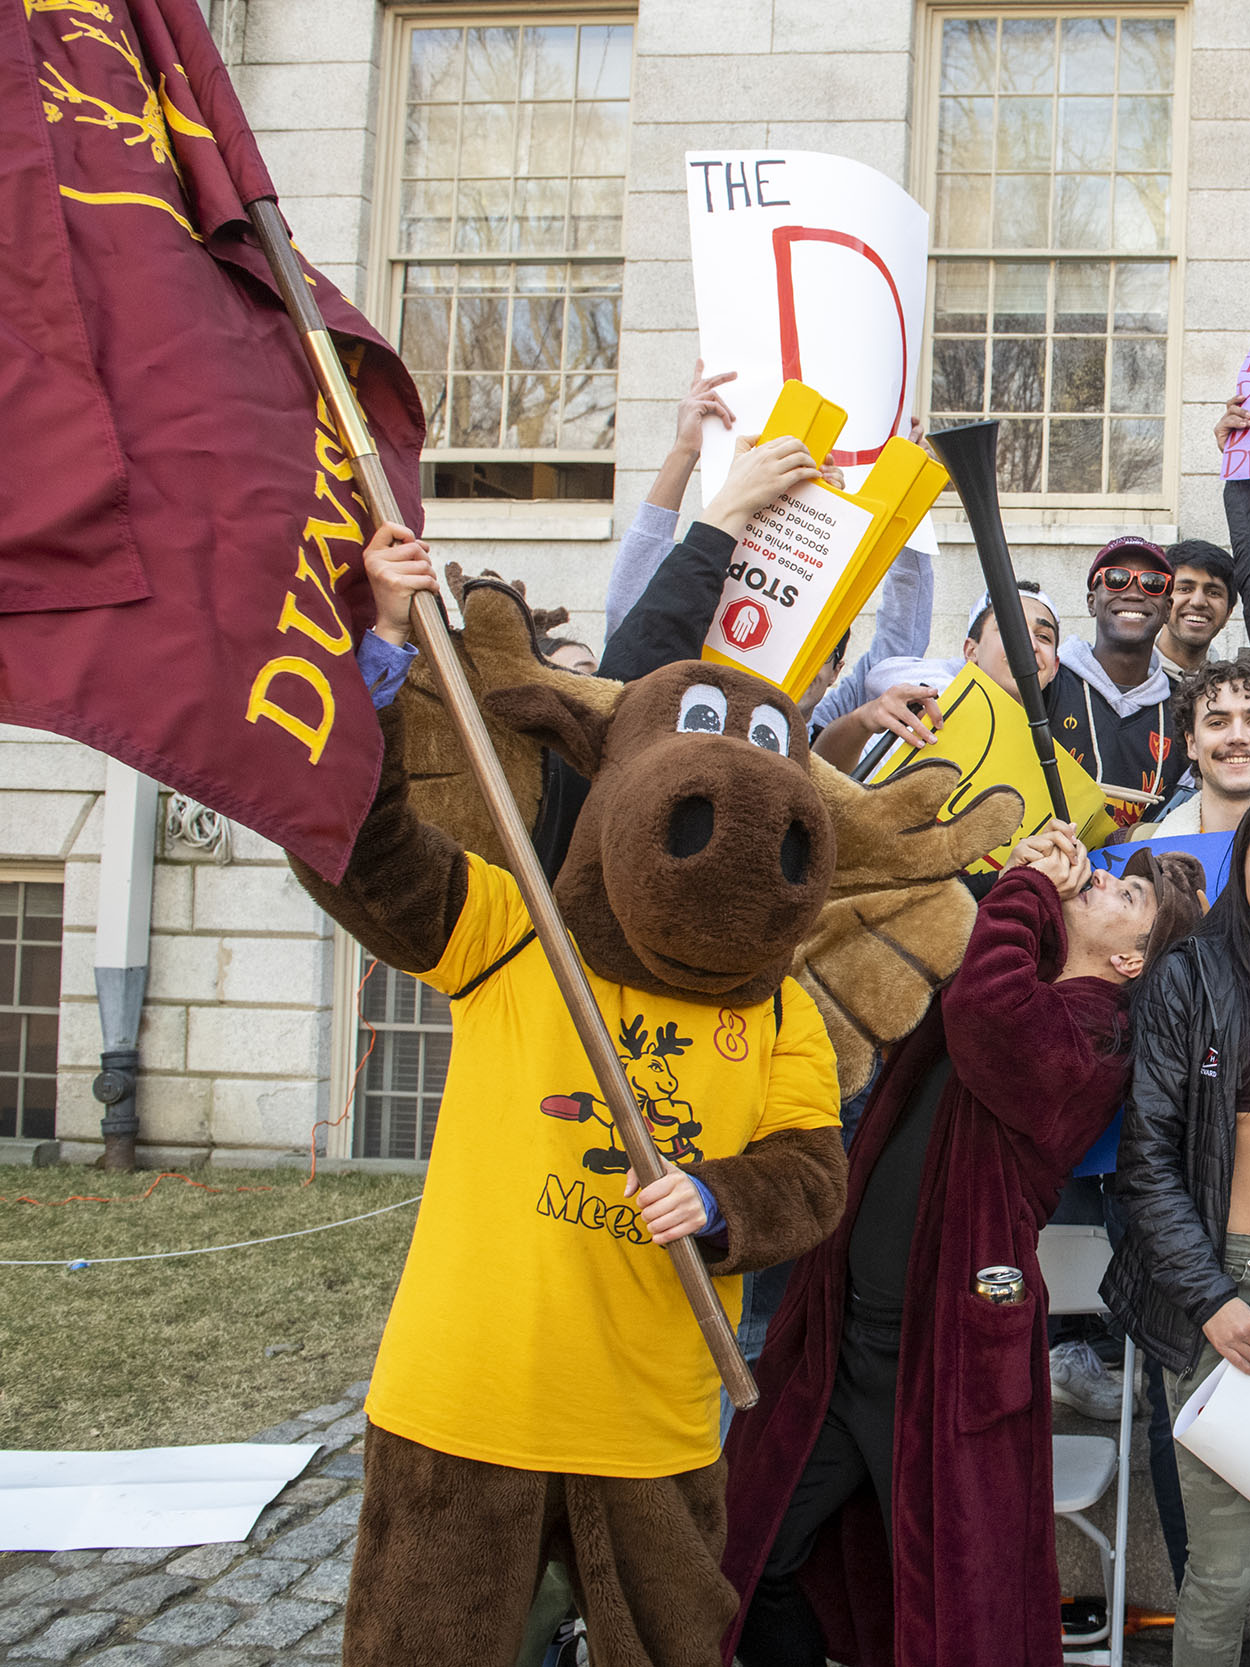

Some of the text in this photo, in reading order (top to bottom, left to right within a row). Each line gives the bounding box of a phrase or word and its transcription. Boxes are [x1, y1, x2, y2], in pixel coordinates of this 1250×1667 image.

[689, 160, 791, 213] THE
[772, 225, 908, 467] D
[753, 511, 829, 556] space is being
[778, 494, 837, 527] replenishe
[787, 514, 831, 540] cleaned
[742, 538, 814, 582] Please do not
[745, 523, 823, 569] enter while the
[728, 561, 799, 608] STOP
[713, 1006, 749, 1062] 8
[536, 1173, 667, 1249] Mees
